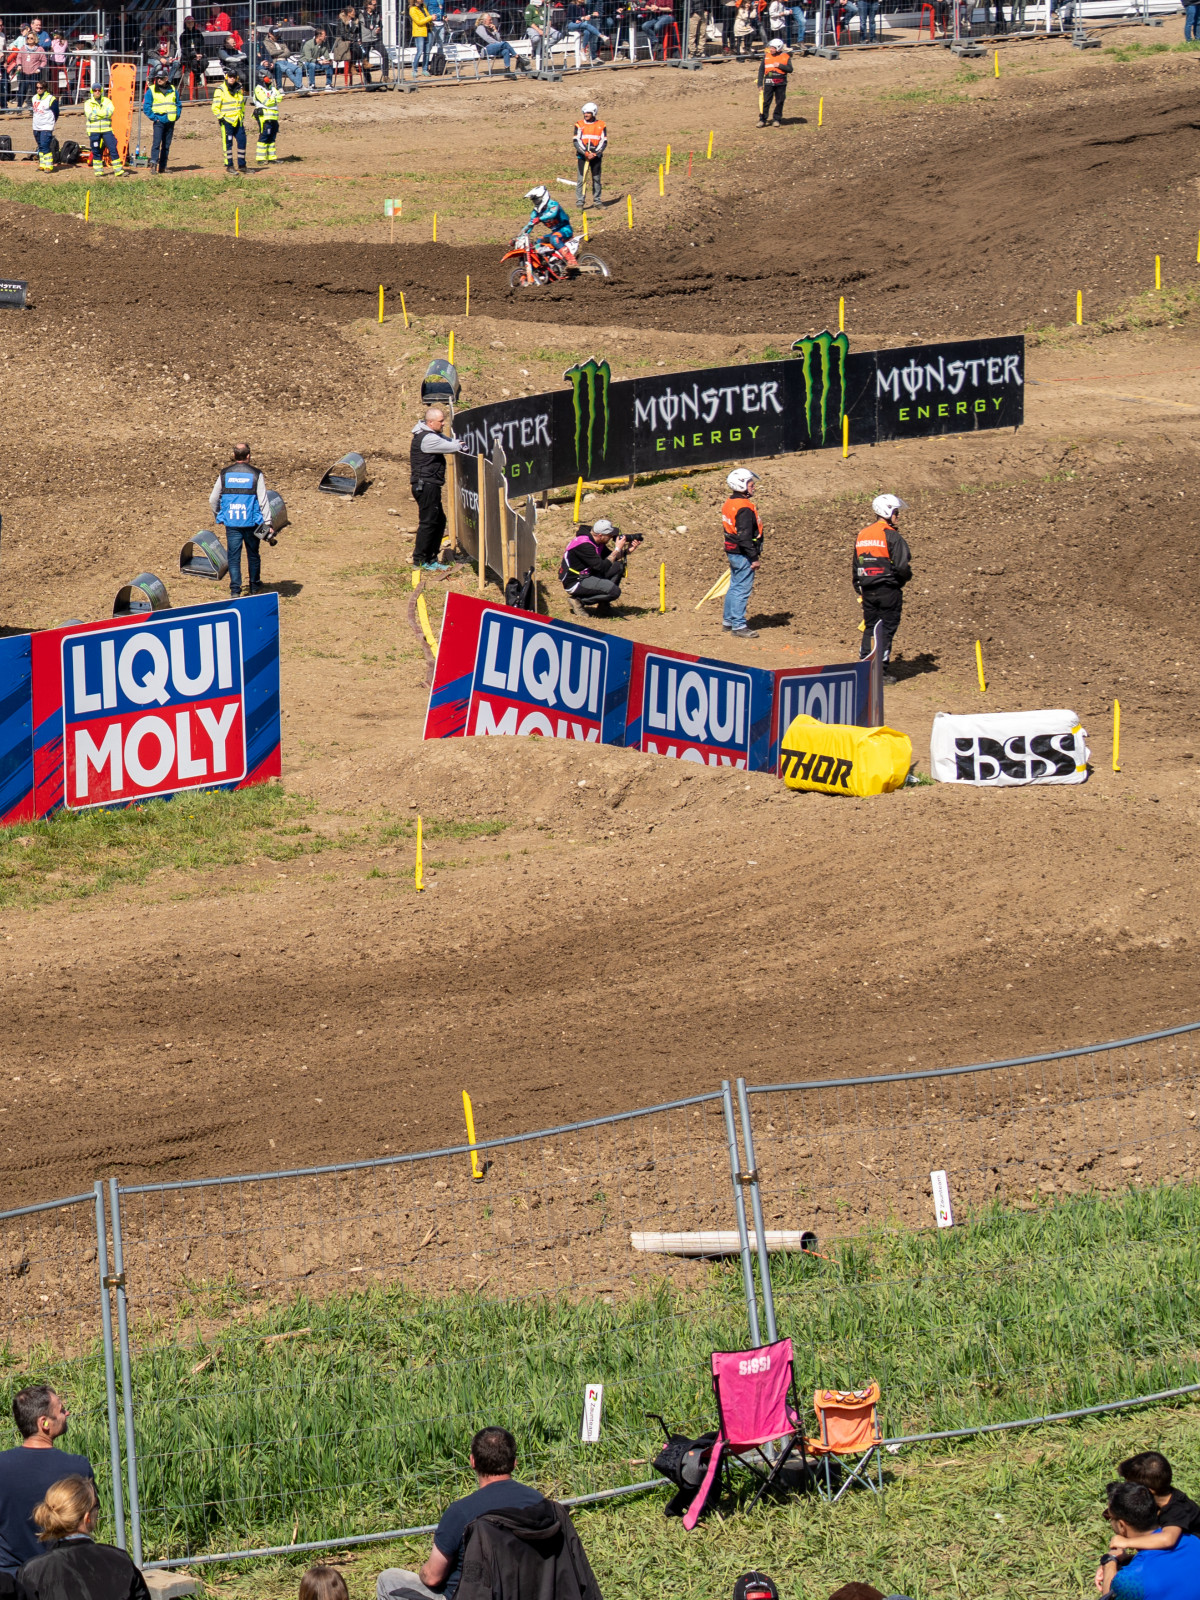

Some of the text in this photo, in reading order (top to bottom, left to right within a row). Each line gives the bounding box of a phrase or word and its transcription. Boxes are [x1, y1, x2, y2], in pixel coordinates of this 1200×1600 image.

[876, 355, 1023, 402] MONSTER
[634, 381, 784, 432] MONSTER
[899, 398, 1002, 421] ENERGY
[458, 413, 552, 456] ONSTER
[656, 425, 760, 451] ENERGY
[228, 510, 247, 520] 111
[72, 621, 233, 714] LIQUI
[482, 620, 601, 714] LIQUI
[648, 664, 746, 744] LIQUI
[74, 702, 240, 799] MOLY
[781, 748, 853, 788] THOR
[739, 1355, 771, 1375] SISSI
[588, 1402, 596, 1436] Zaunteam
